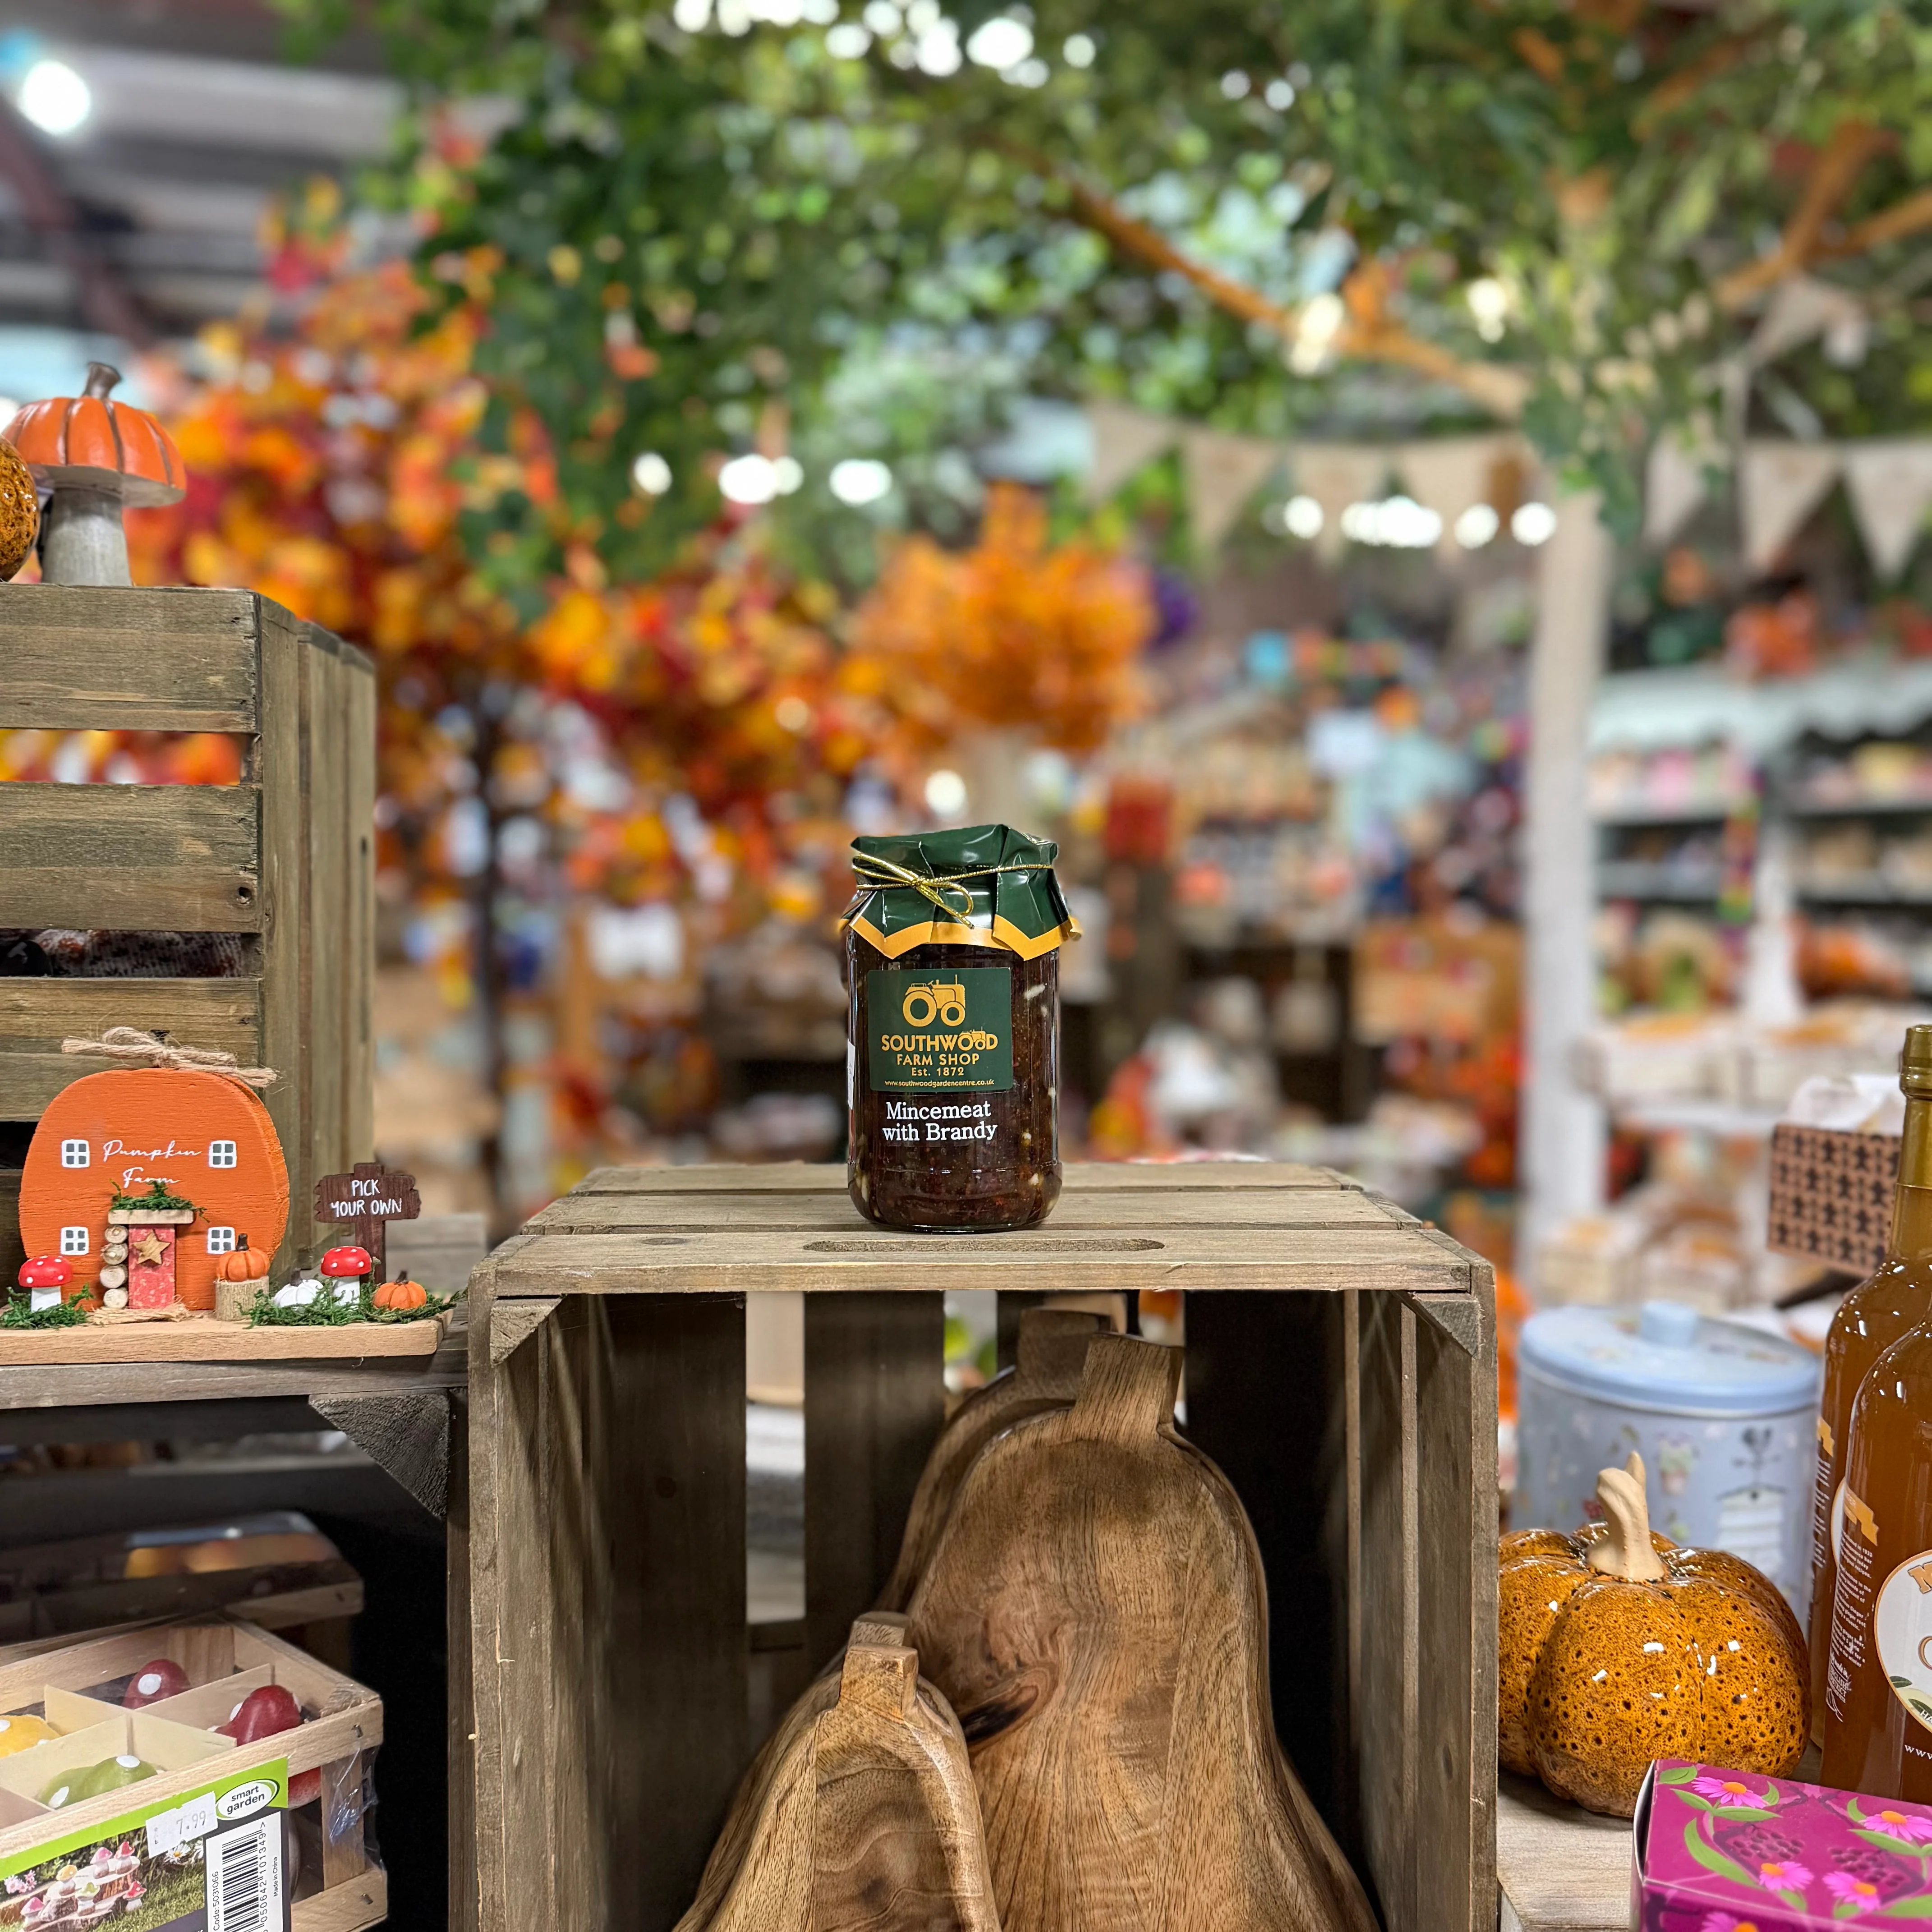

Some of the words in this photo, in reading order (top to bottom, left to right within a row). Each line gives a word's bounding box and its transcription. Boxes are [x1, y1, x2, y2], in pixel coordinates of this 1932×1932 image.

[881, 1034, 998, 1051] SOUTHWOOD
[897, 1054, 933, 1066] FARM
[938, 1053, 980, 1065] SHOP
[911, 1067, 931, 1076] Est.
[936, 1067, 964, 1076] 1872
[884, 1078, 994, 1088] www.southwoodgardencentre.co.uk
[886, 1100, 992, 1120] Mincemeat
[882, 1123, 920, 1141] with
[926, 1121, 998, 1141] Brandy
[103, 1140, 202, 1162] Pumpkin
[123, 1167, 180, 1188] Farm
[351, 1179, 381, 1196] PICK
[331, 1200, 366, 1217] YOUR
[371, 1198, 402, 1215] OWN
[231, 1785, 259, 1802] smart
[227, 1793, 265, 1815] garden
[176, 1810, 206, 1835] 7.99
